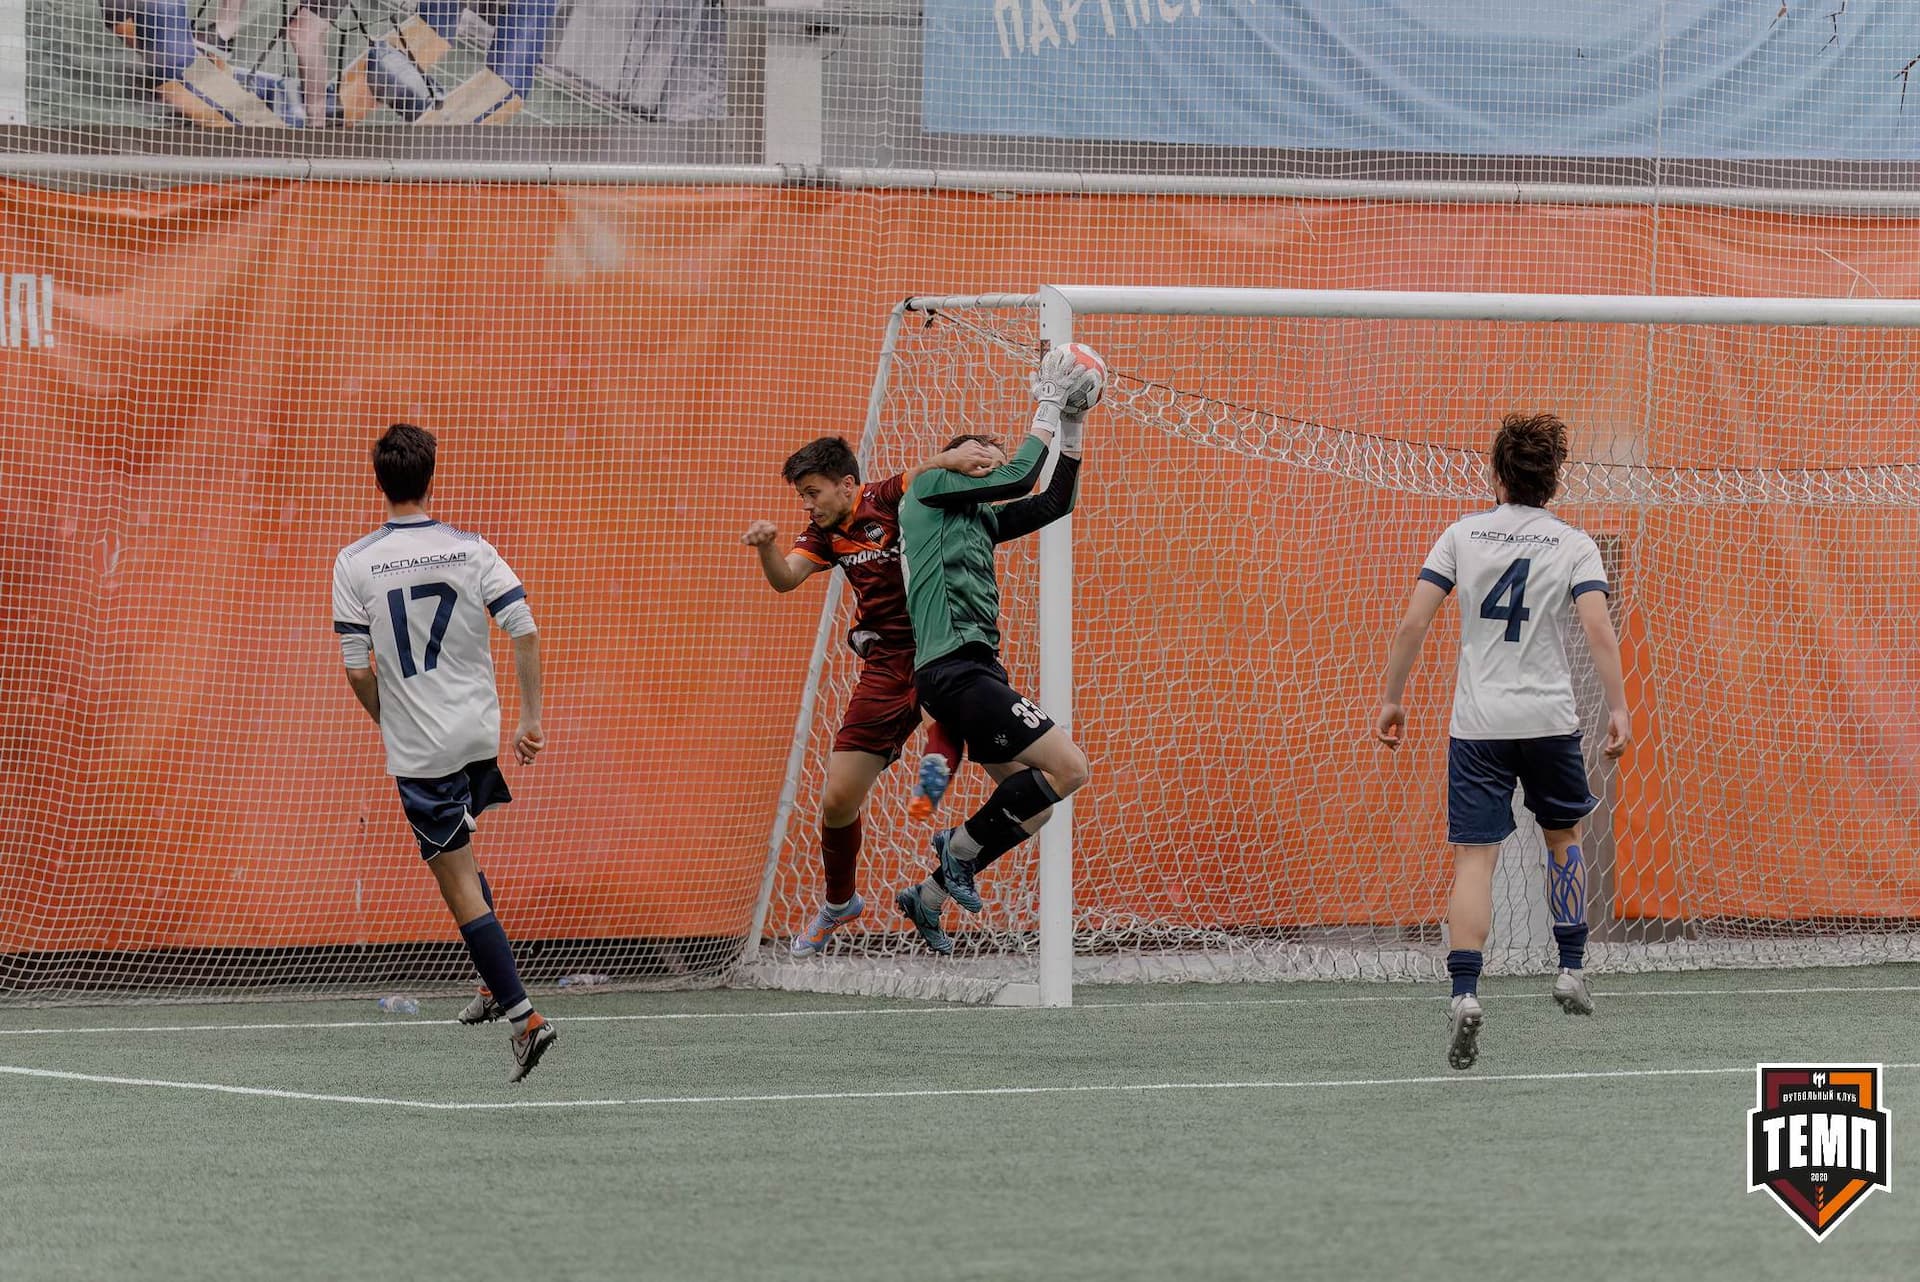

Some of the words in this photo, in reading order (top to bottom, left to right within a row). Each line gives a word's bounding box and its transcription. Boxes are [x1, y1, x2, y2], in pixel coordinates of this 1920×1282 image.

[0, 272, 54, 348] П!
[371, 552, 466, 575] РАСПАДСКАЯ
[1480, 558, 1531, 643] 4
[387, 582, 458, 679] 17
